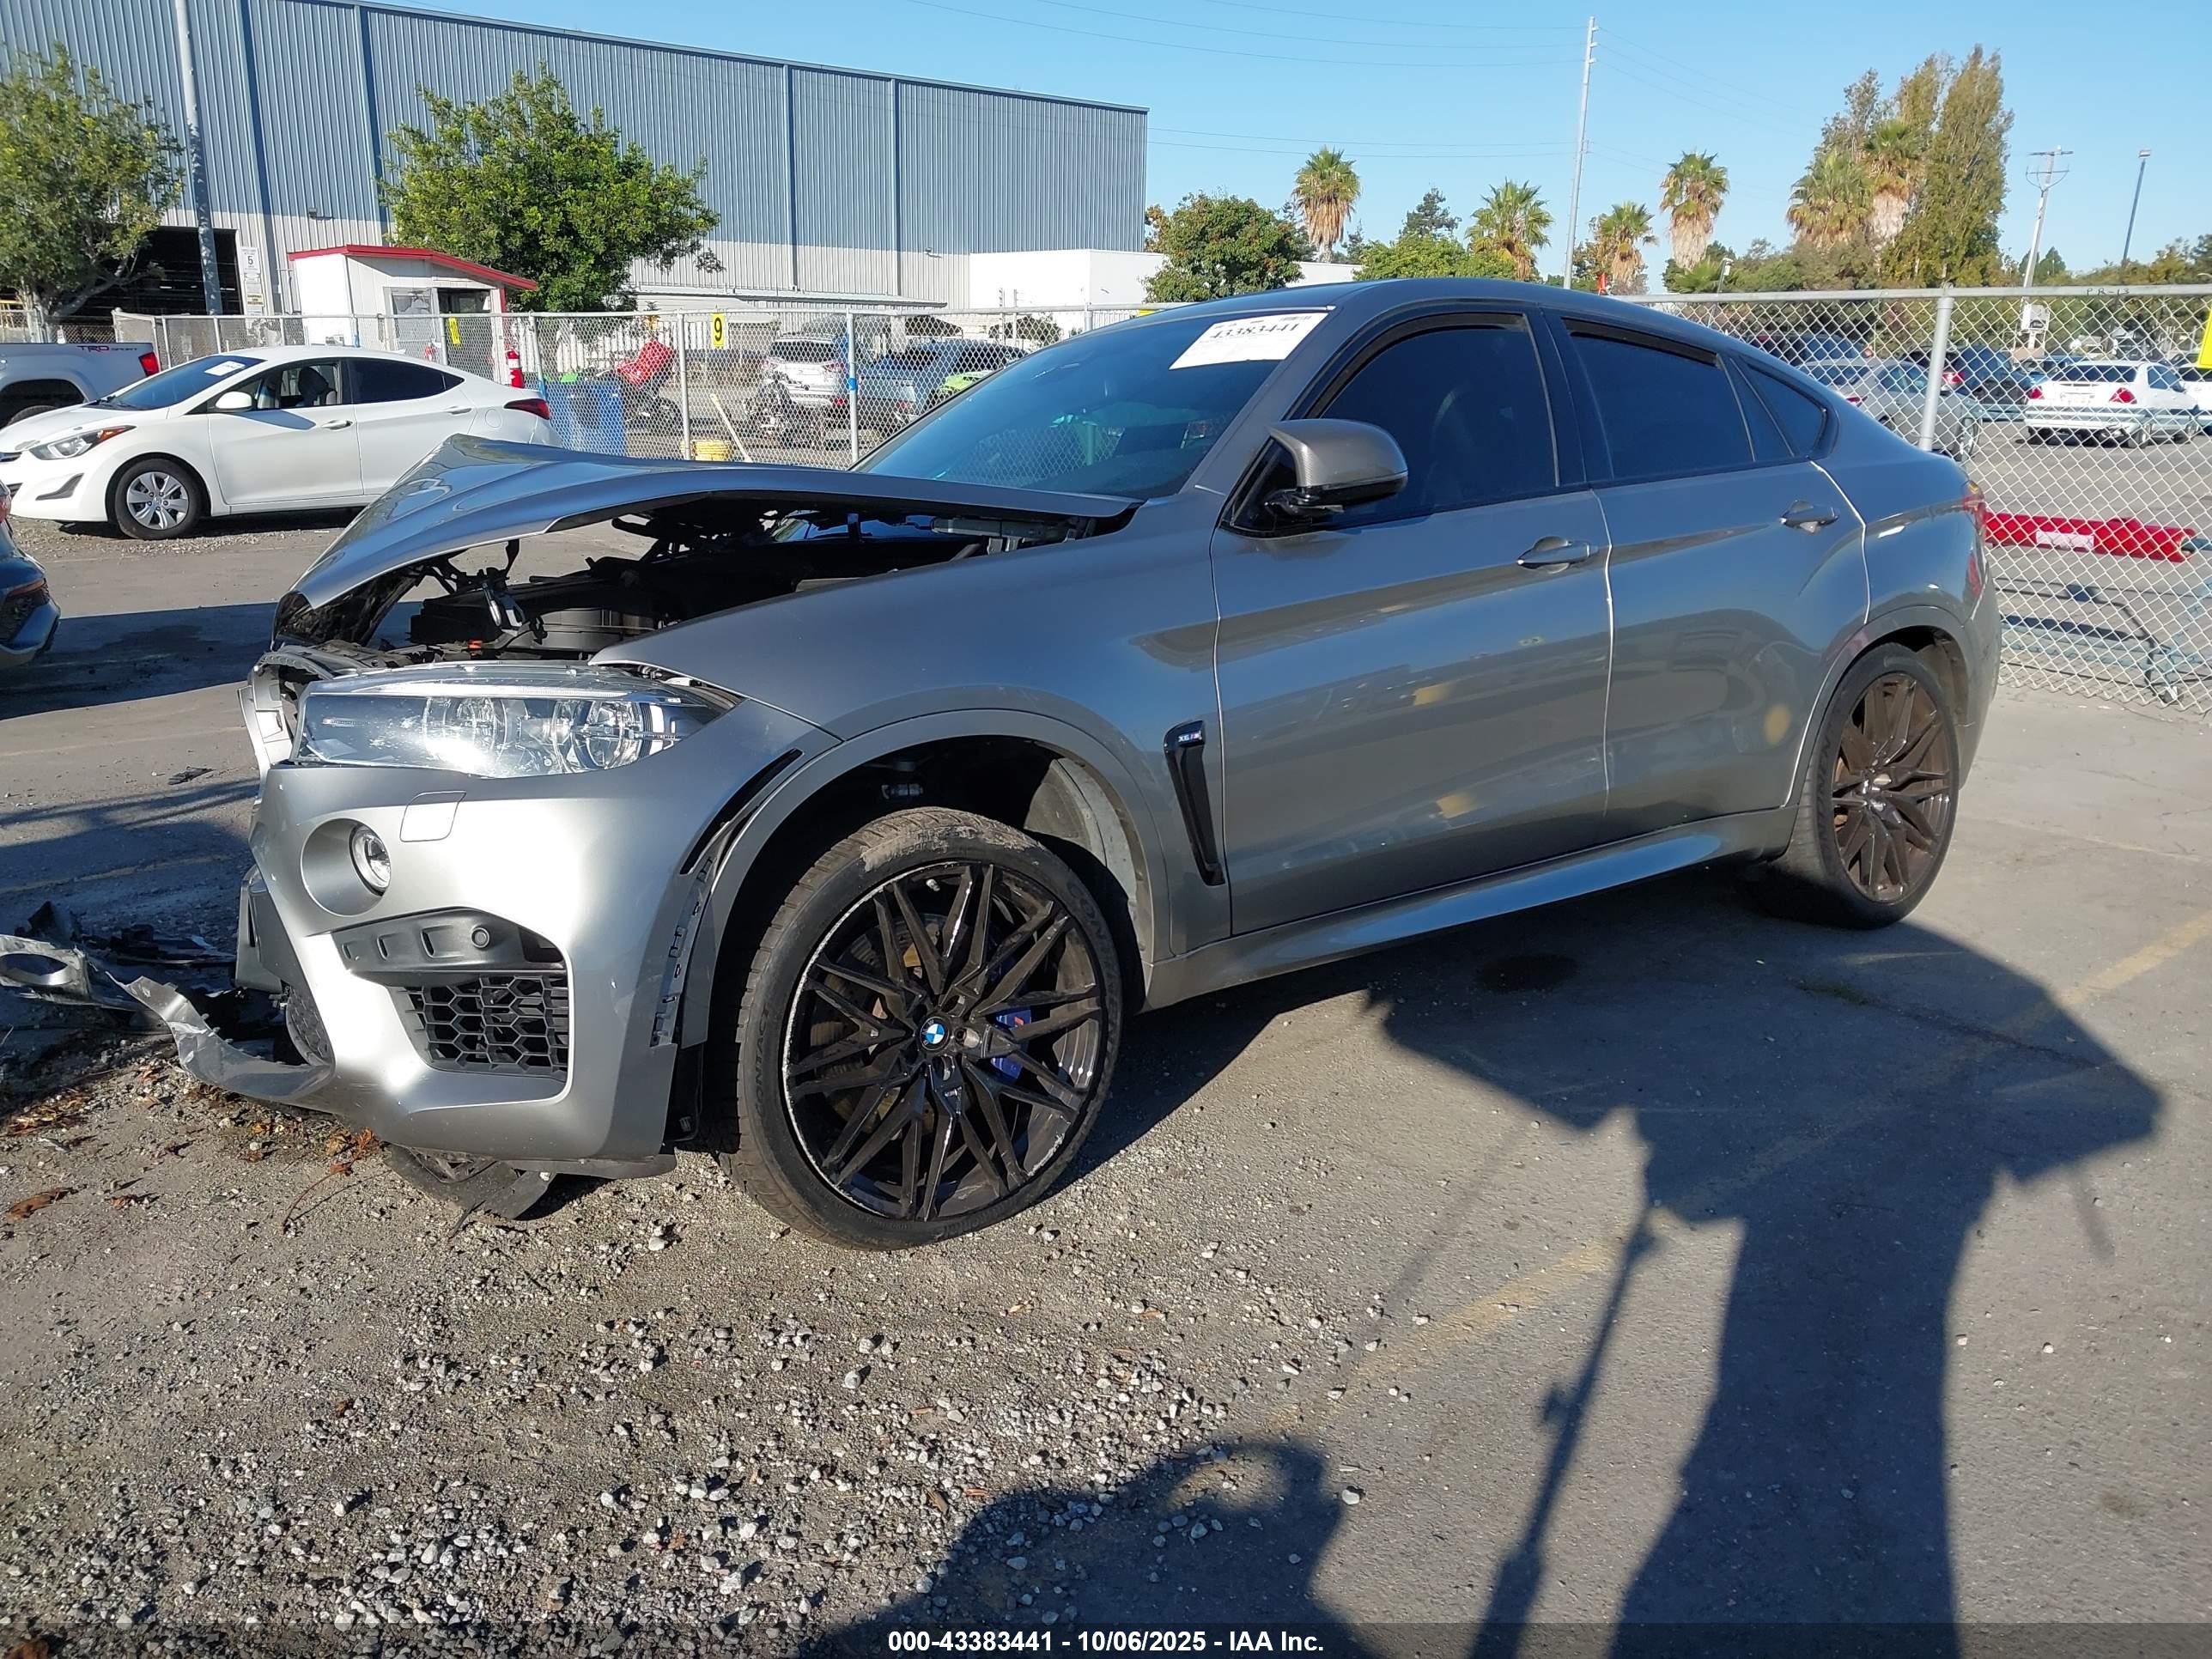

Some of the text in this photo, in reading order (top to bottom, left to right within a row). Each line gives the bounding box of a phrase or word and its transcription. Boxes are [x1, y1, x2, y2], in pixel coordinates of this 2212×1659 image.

[247, 255, 253, 265] 5
[714, 317, 722, 342] 9
[1209, 323, 1300, 338] 43383441
